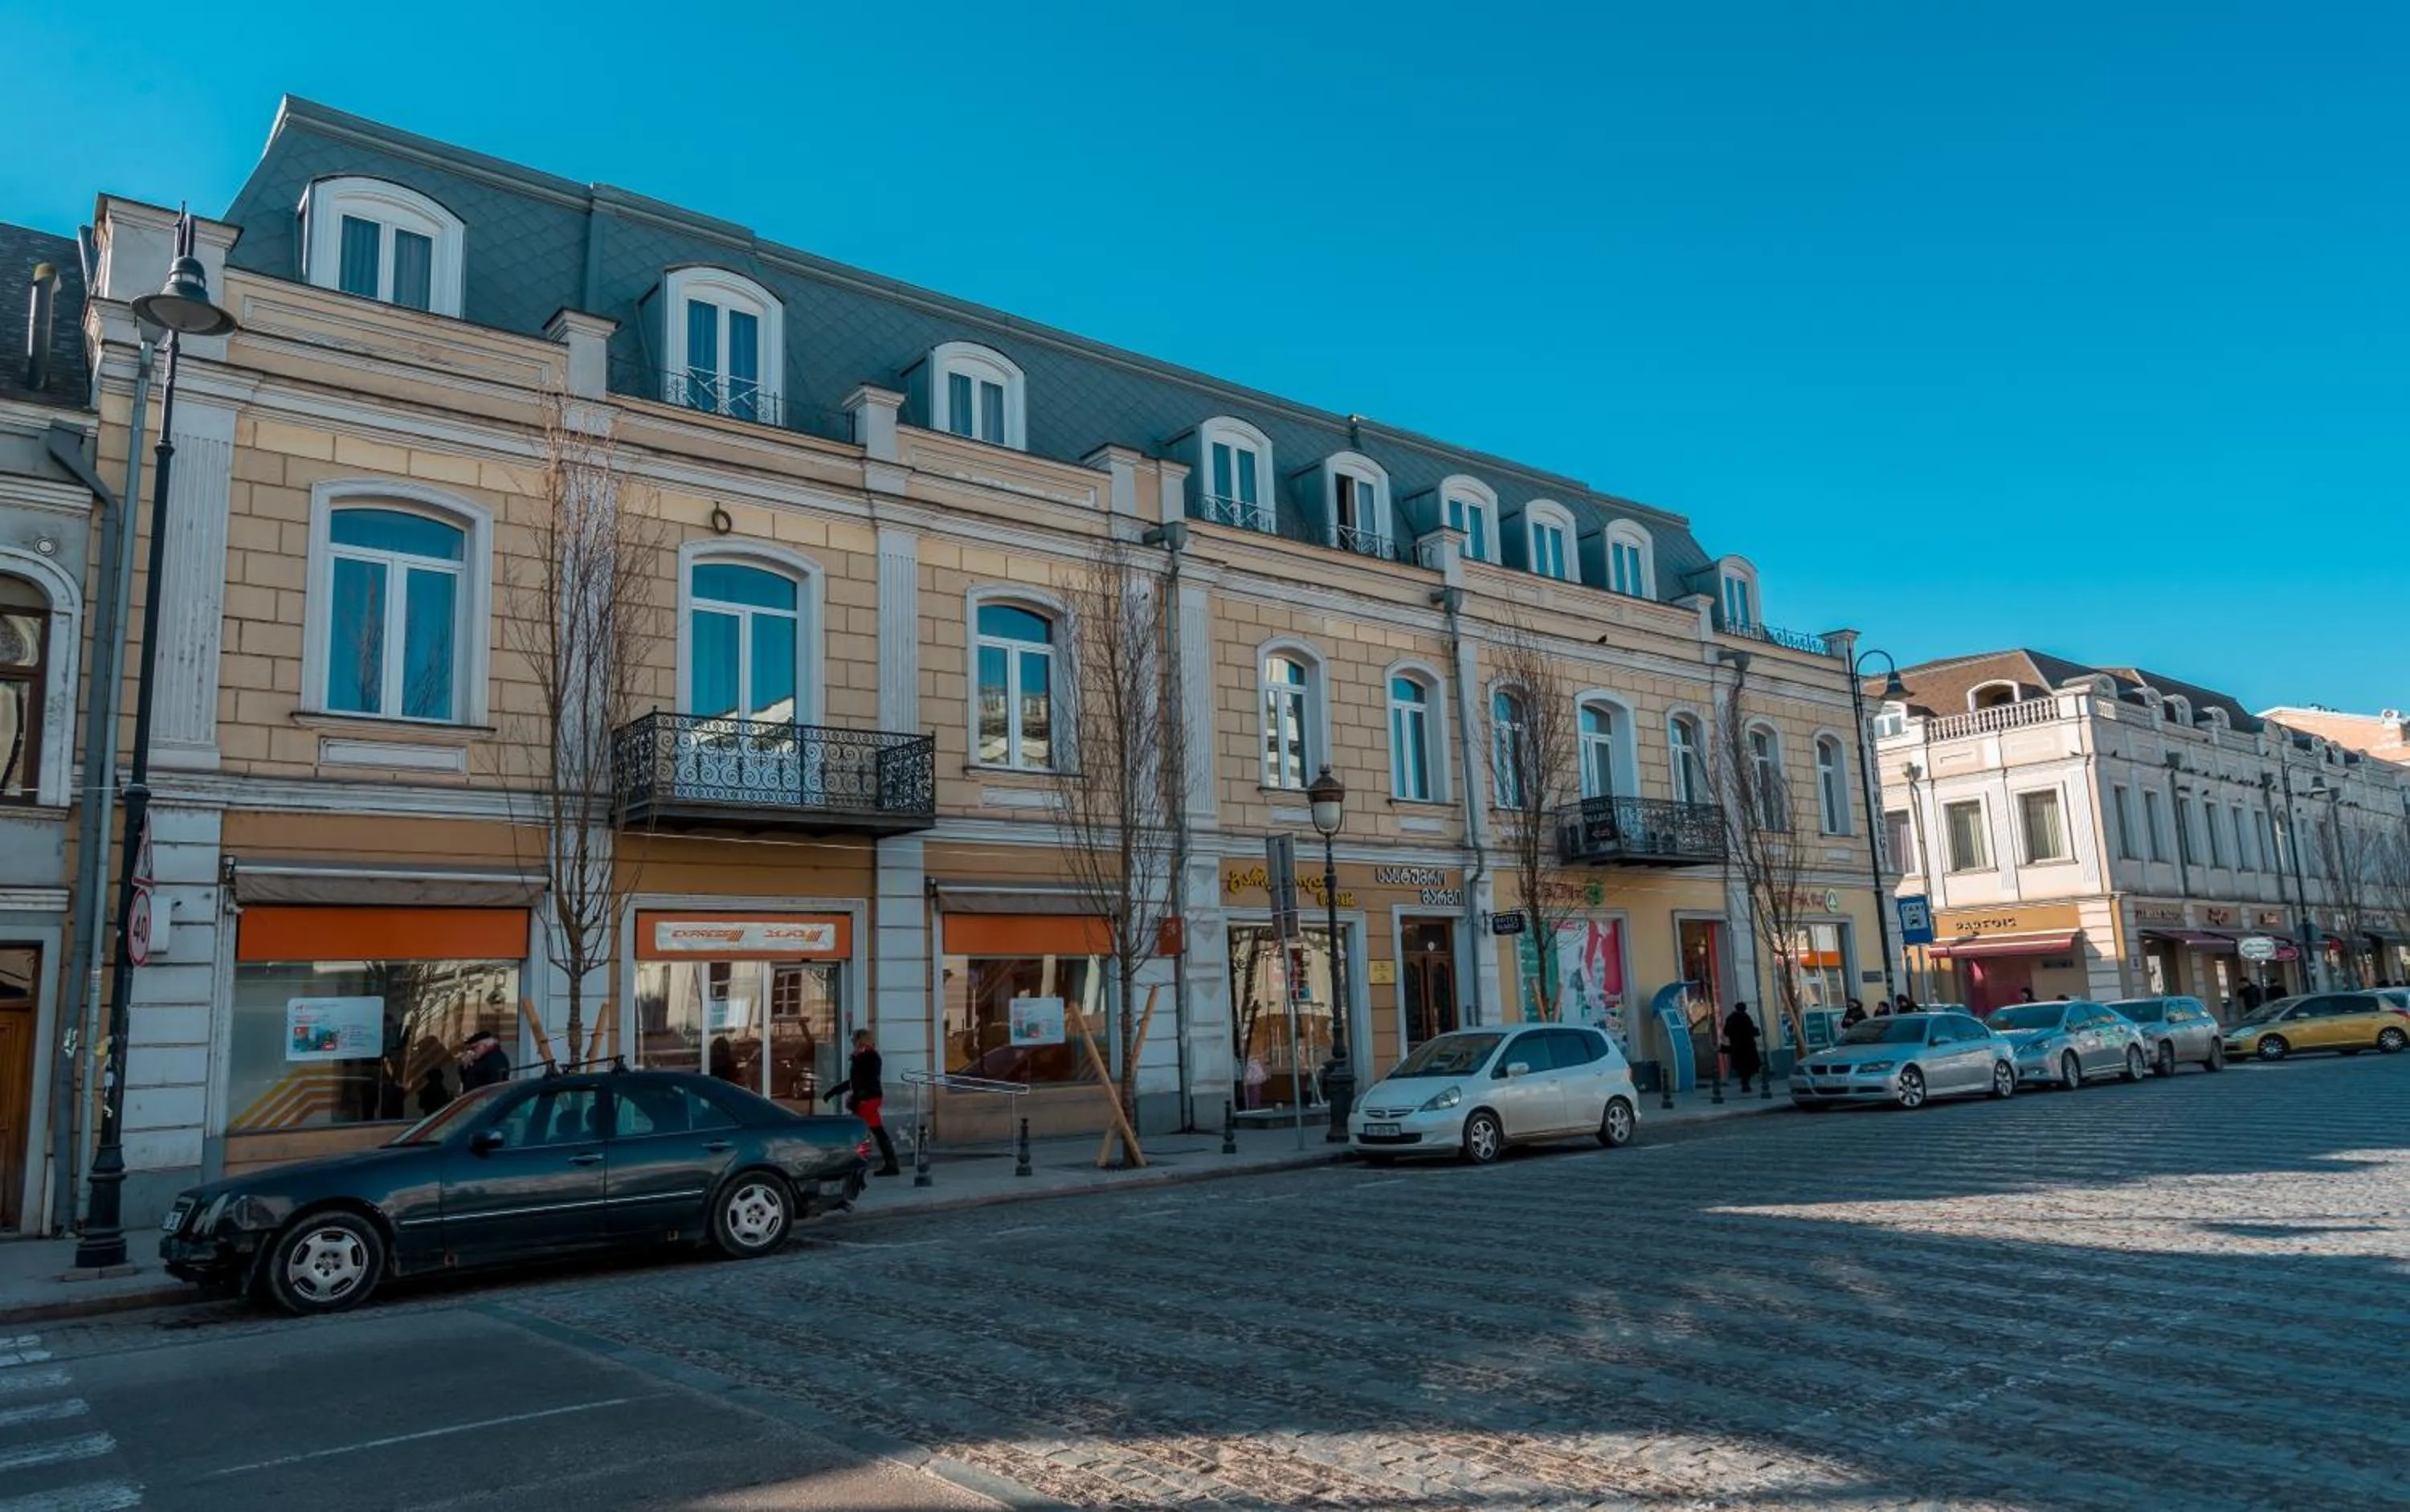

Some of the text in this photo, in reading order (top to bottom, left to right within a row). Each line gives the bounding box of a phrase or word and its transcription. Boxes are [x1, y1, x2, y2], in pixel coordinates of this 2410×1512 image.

[1375, 866, 1446, 885] სასტუმრო
[133, 914, 147, 944] 40
[672, 929, 733, 938] EXPRESS
